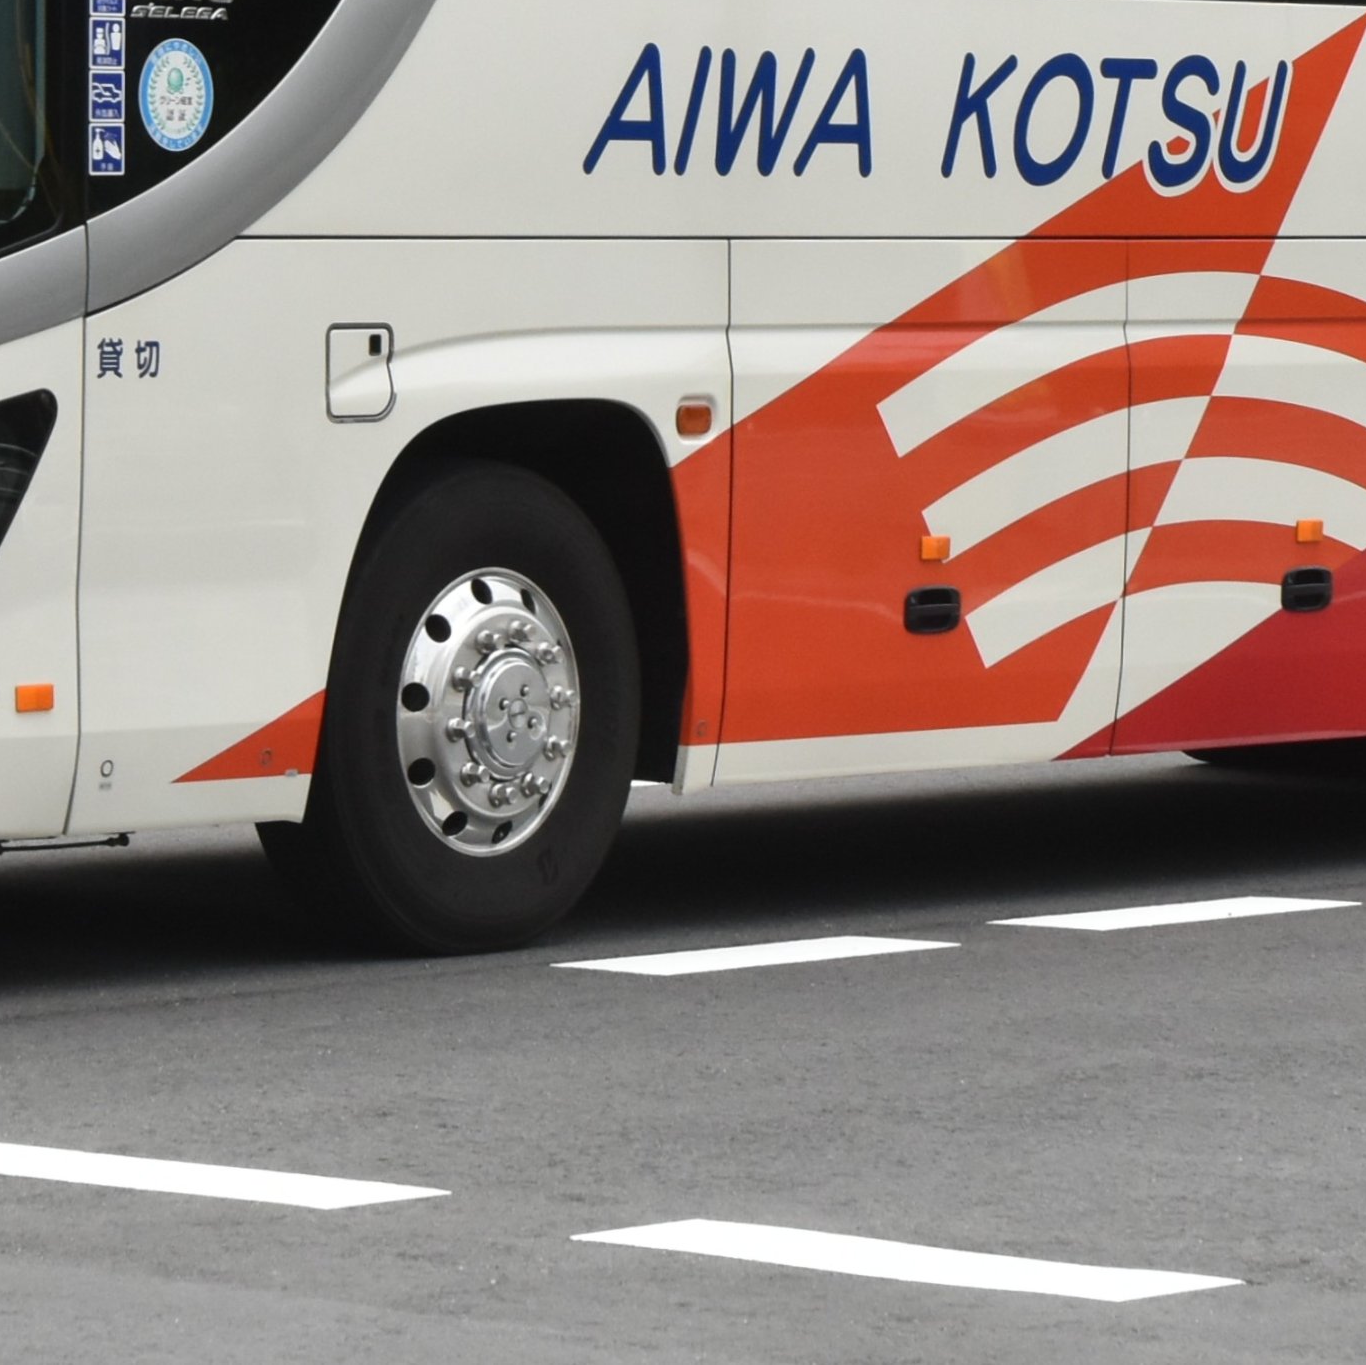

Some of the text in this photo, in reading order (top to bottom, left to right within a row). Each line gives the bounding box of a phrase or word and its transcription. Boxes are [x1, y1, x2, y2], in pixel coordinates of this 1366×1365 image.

[582, 42, 1289, 188] AIWA KOTSU
[96, 337, 161, 379] 貸切
